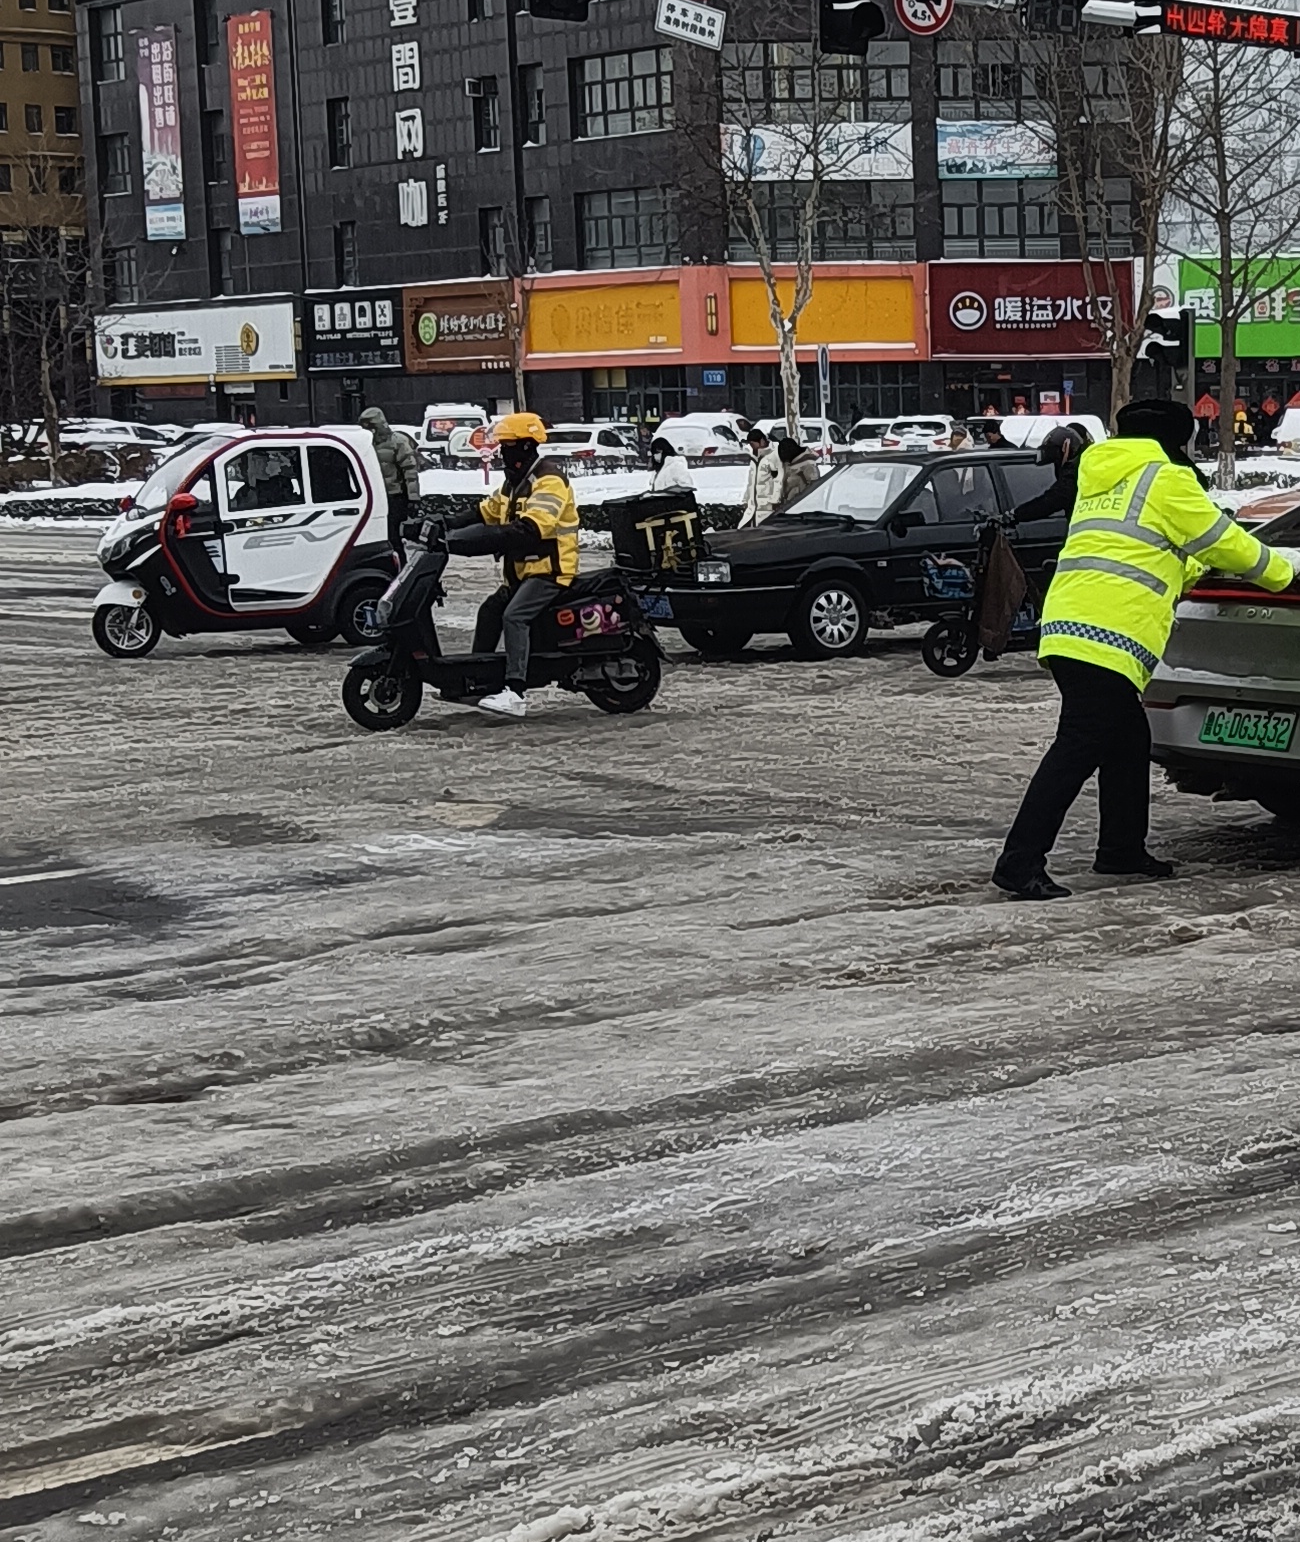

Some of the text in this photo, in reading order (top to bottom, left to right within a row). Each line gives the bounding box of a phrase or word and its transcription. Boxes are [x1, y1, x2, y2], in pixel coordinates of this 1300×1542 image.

[666, 2, 716, 28] 停车泊位
[911, 10, 932, 22] 4.5t
